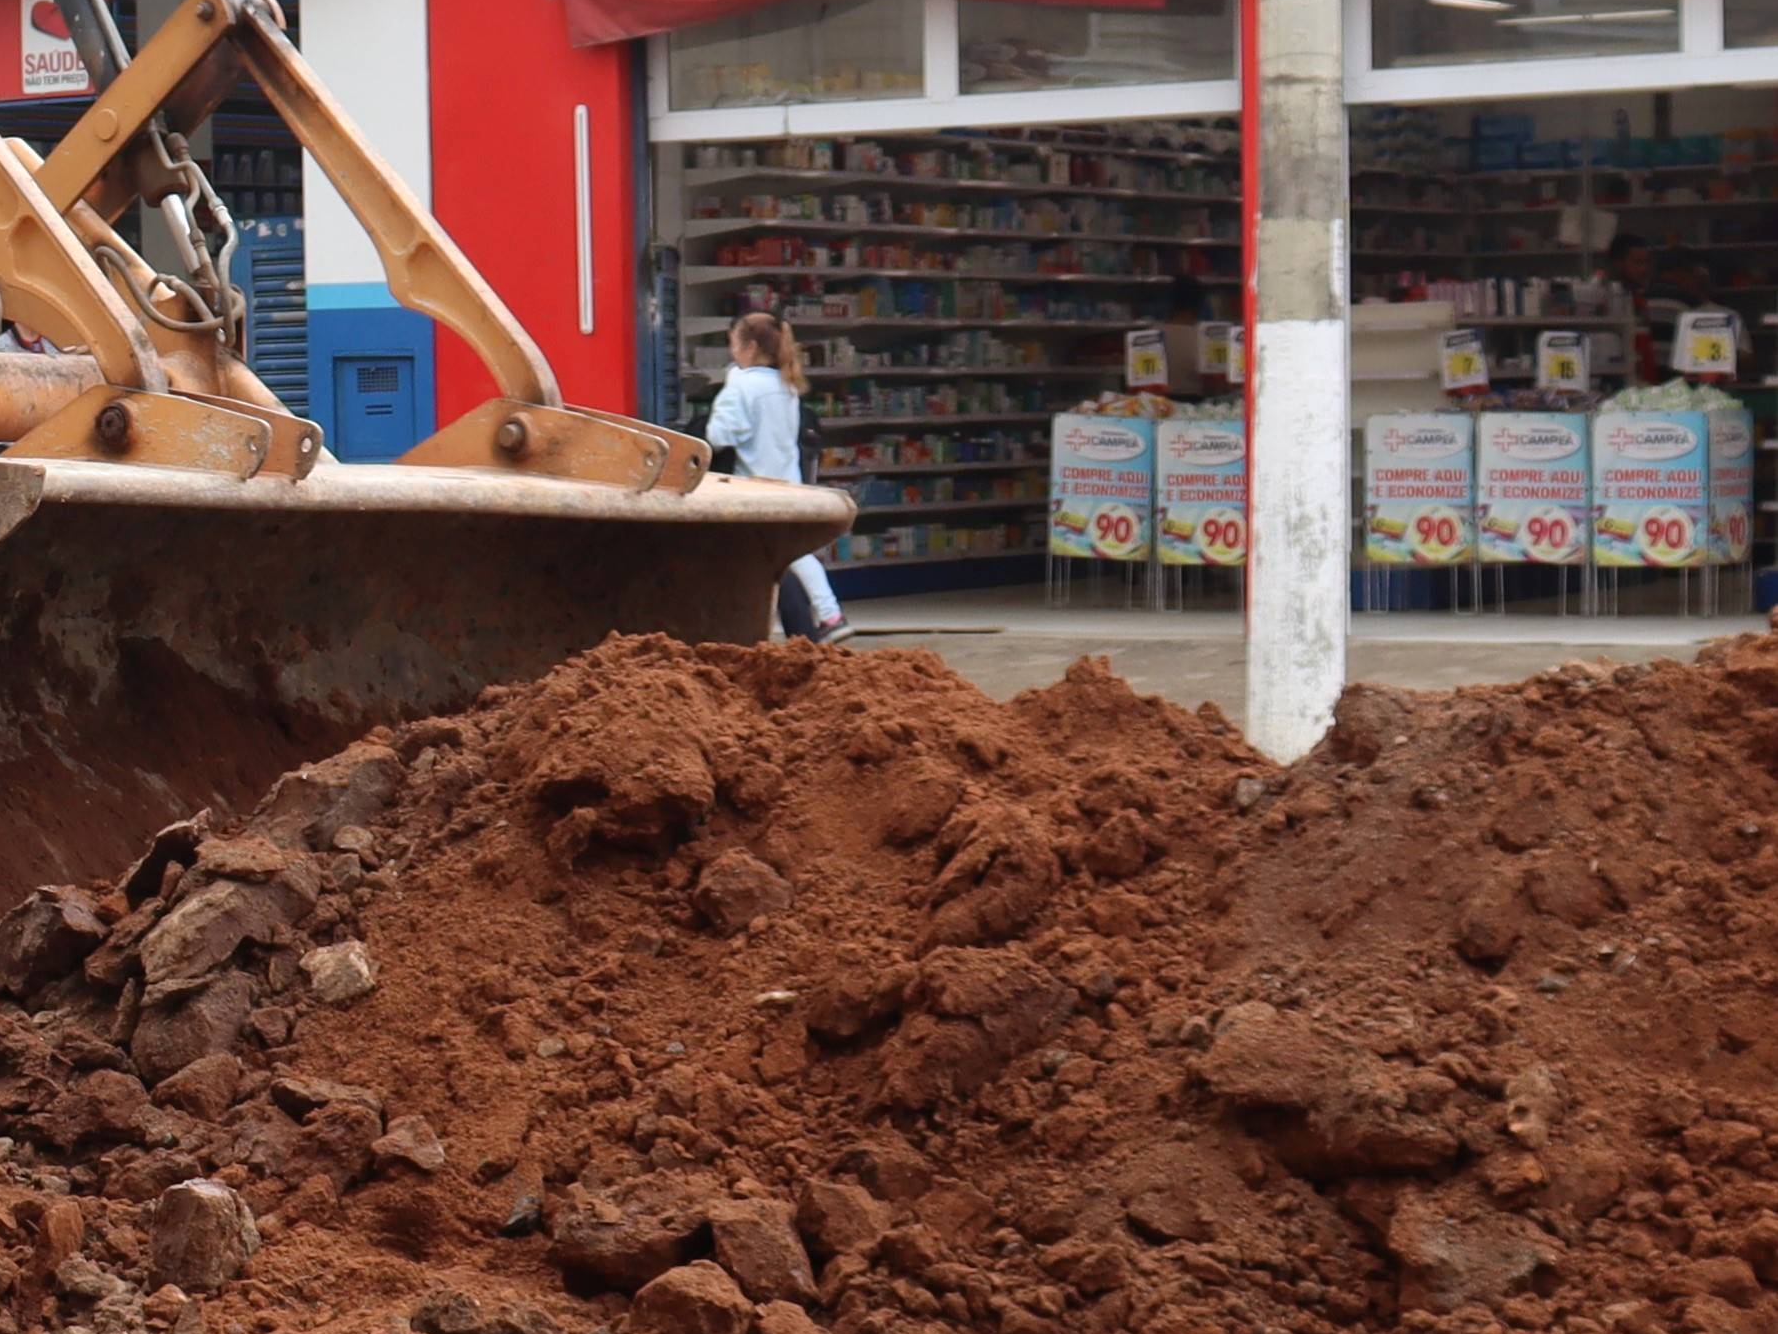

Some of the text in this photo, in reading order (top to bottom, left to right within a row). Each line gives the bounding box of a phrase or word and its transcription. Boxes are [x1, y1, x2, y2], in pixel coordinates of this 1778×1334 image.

[43, 74, 60, 85] TEM
[1062, 467, 1113, 481] COMPRE
[1167, 473, 1220, 486] COMPRE
[1376, 468, 1431, 482] COMPRE
[1489, 469, 1544, 483] COMPRE
[1605, 468, 1662, 482] COMPRE
[1061, 482, 1150, 500] E ECONOMIZE
[1167, 489, 1173, 502] E
[1375, 485, 1467, 499] E ECONOMIZE
[1489, 485, 1585, 501] E ECONOMIZE
[1604, 486, 1703, 500] E ECONOMIZE
[1096, 514, 1134, 544] 90
[1203, 518, 1240, 549] 90
[1416, 515, 1456, 547] 90
[1527, 516, 1569, 548] 90
[1644, 518, 1685, 549] 90
